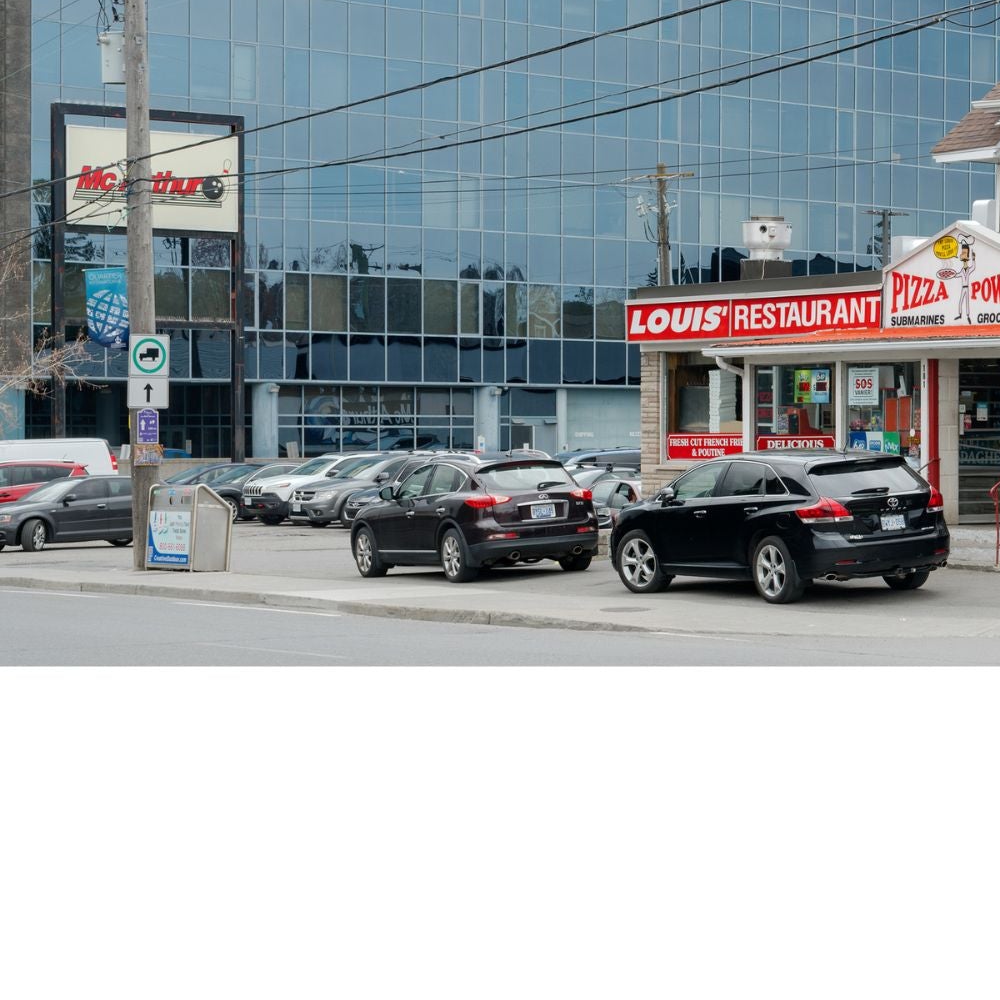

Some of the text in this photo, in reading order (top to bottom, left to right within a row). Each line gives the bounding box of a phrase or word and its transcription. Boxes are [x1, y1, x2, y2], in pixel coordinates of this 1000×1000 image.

[890, 271, 949, 314] PIZZA
[629, 296, 881, 334] LOUIS' RESTAURANT
[890, 314, 945, 327] SUBMARINES
[855, 378, 873, 389] SOS
[669, 438, 689, 447] FRESH
[690, 438, 702, 447] CUT
[703, 438, 728, 447] FRENCH
[767, 439, 824, 449] DELICIOUS
[691, 448, 726, 457] & POUTINE
